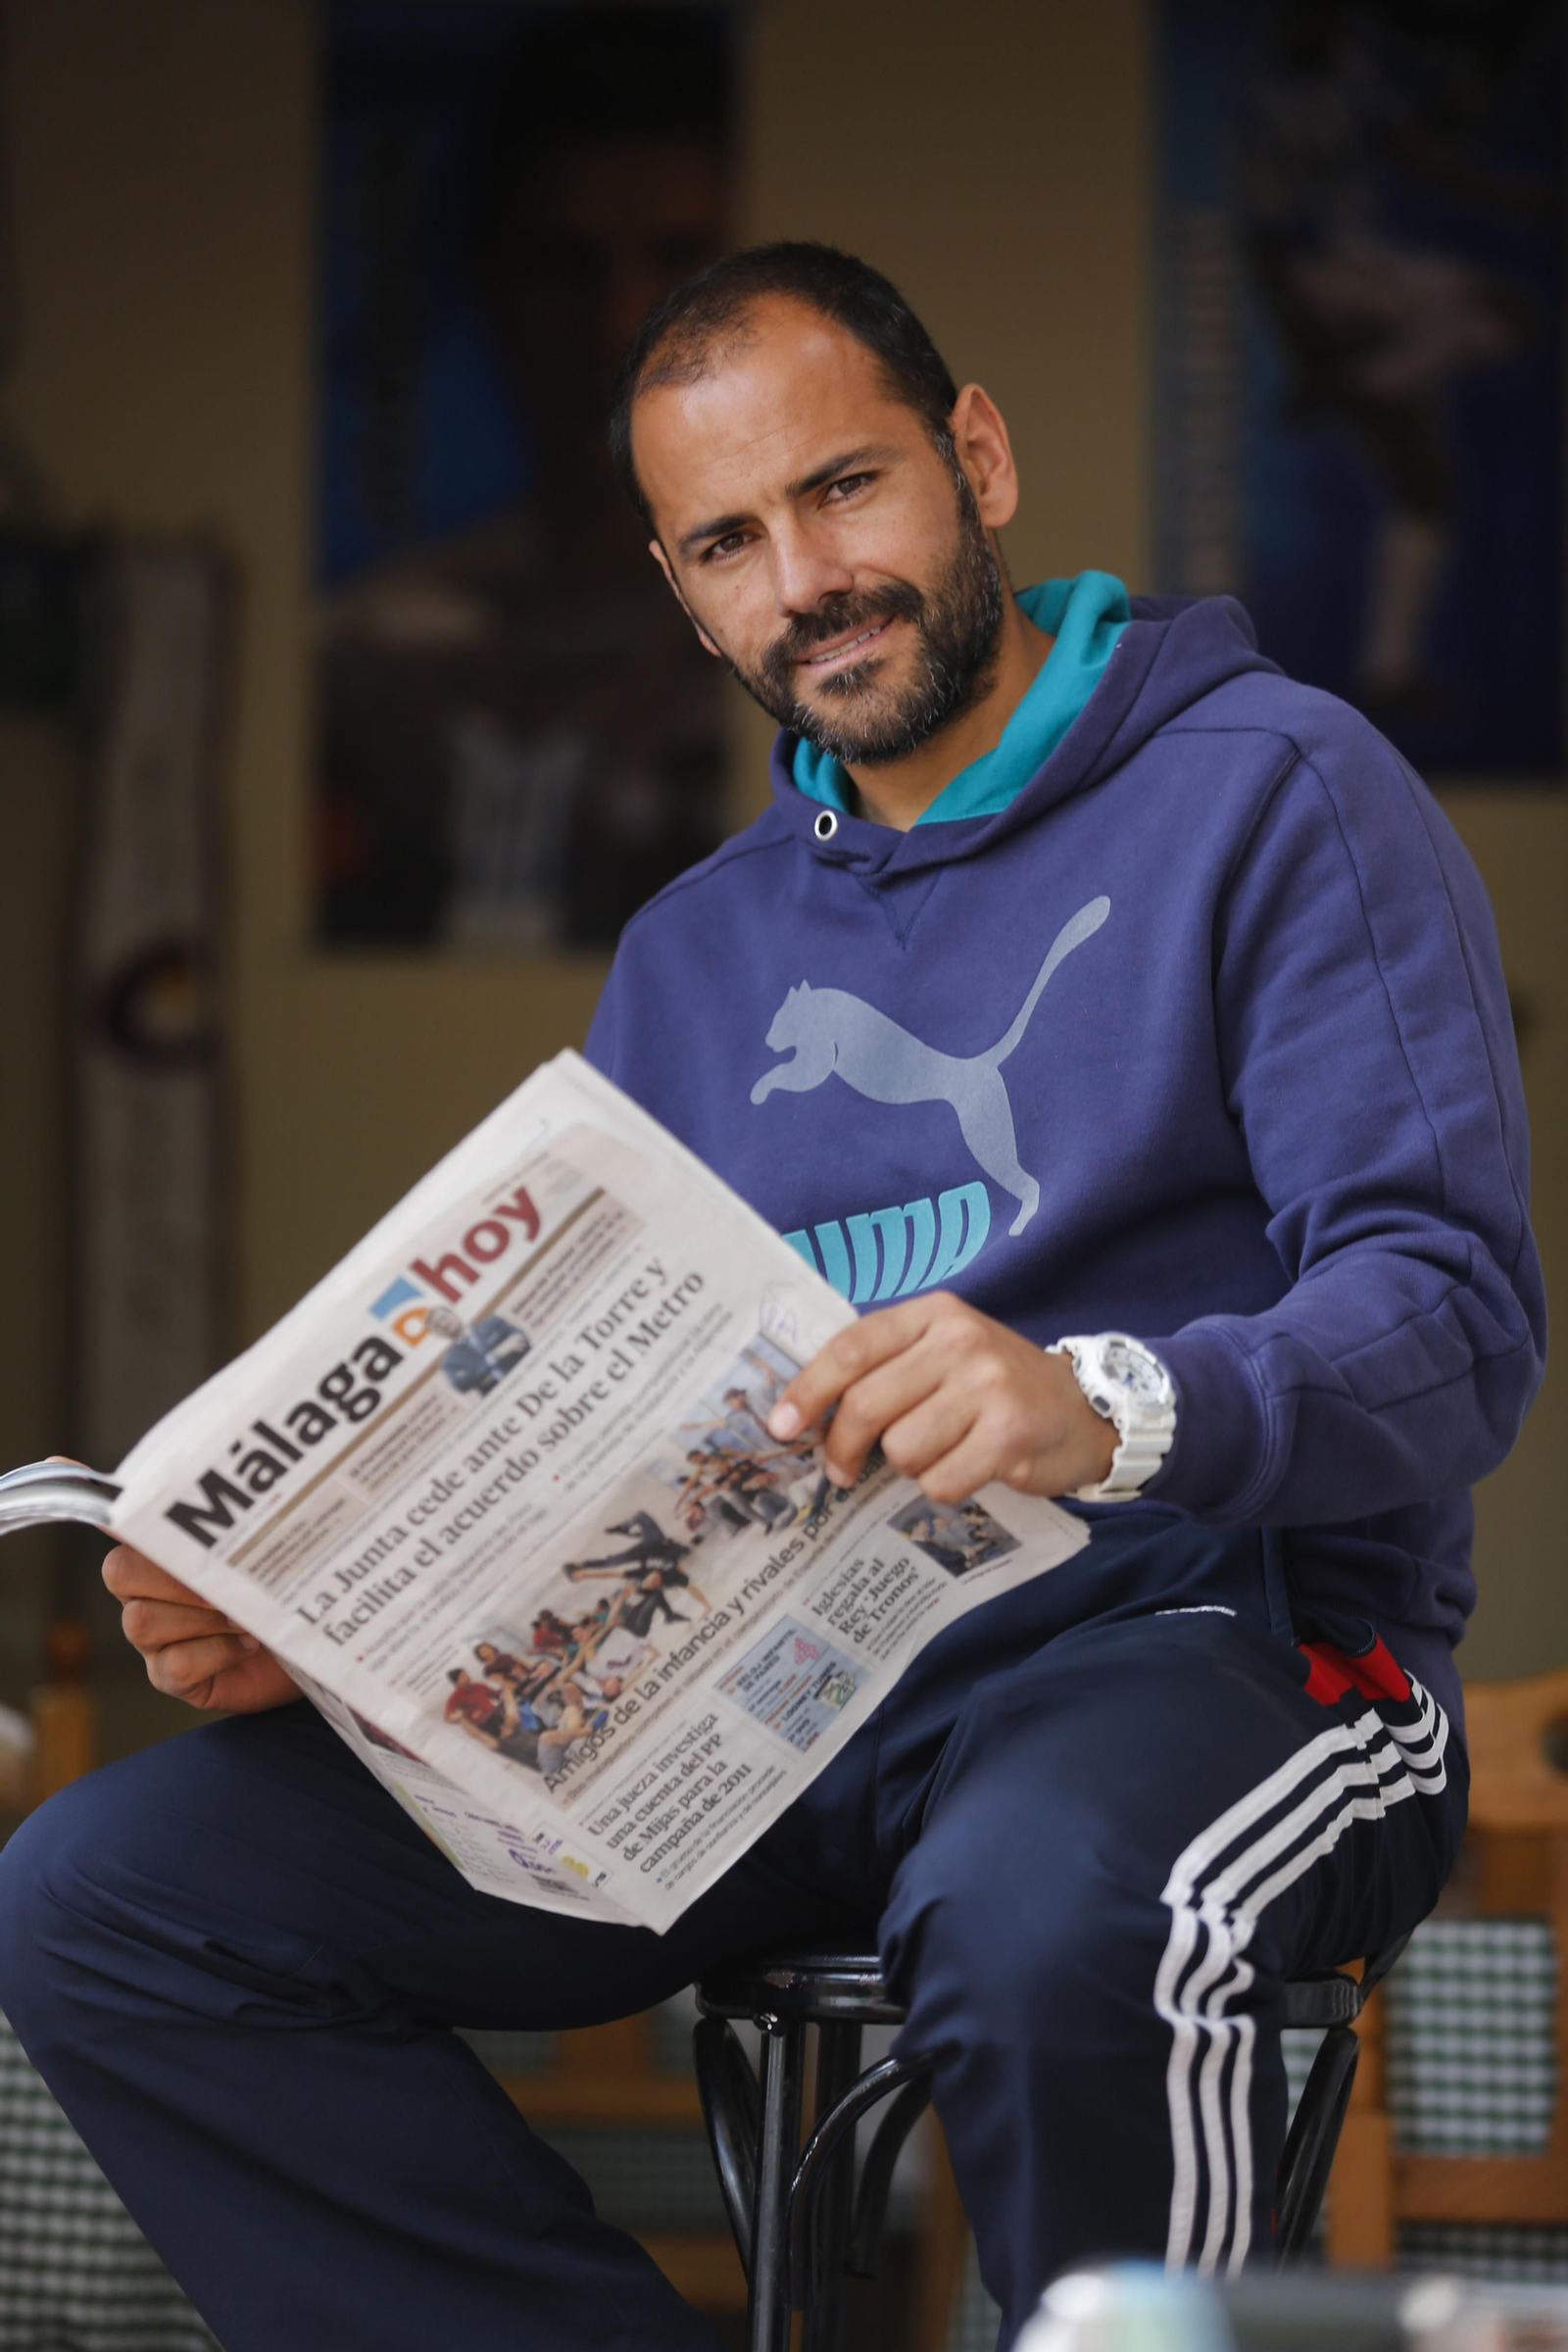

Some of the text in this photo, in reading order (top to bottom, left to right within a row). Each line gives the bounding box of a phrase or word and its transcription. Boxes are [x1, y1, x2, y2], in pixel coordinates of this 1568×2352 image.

[781, 1181, 991, 1304] UMA
[164, 1336, 403, 1548] Málaga
[409, 1186, 541, 1303] hoy
[295, 1591, 338, 1626] La
[332, 1525, 409, 1593] Junta
[406, 1470, 465, 1526] cede
[463, 1416, 521, 1474] ante
[514, 1381, 558, 1418] De
[547, 1353, 585, 1383] la
[574, 1278, 649, 1350] Torre
[645, 1259, 666, 1286] y
[321, 1566, 417, 1646] facilita
[413, 1537, 443, 1568] el
[439, 1449, 540, 1544] acuerdo
[537, 1381, 609, 1447] sobre
[606, 1348, 634, 1382] el
[625, 1272, 704, 1347] Metro
[811, 1557, 864, 1617] Iglesias
[824, 1557, 884, 1625] regala al
[838, 1604, 868, 1634] Rey
[850, 1622, 871, 1643] de
[542, 1721, 615, 1794] Amigos
[611, 1695, 640, 1725] de
[636, 1676, 660, 1699] la
[655, 1606, 730, 1681] infancia
[728, 1597, 747, 1616] y
[738, 1534, 805, 1599] rivales
[803, 1504, 835, 1542] por
[588, 1710, 720, 1837] Una jueza investiga
[605, 1733, 724, 1849] una cuenta del PP
[620, 1757, 727, 1861] de Mijas para la
[638, 1762, 752, 1874] campaña de 2011
